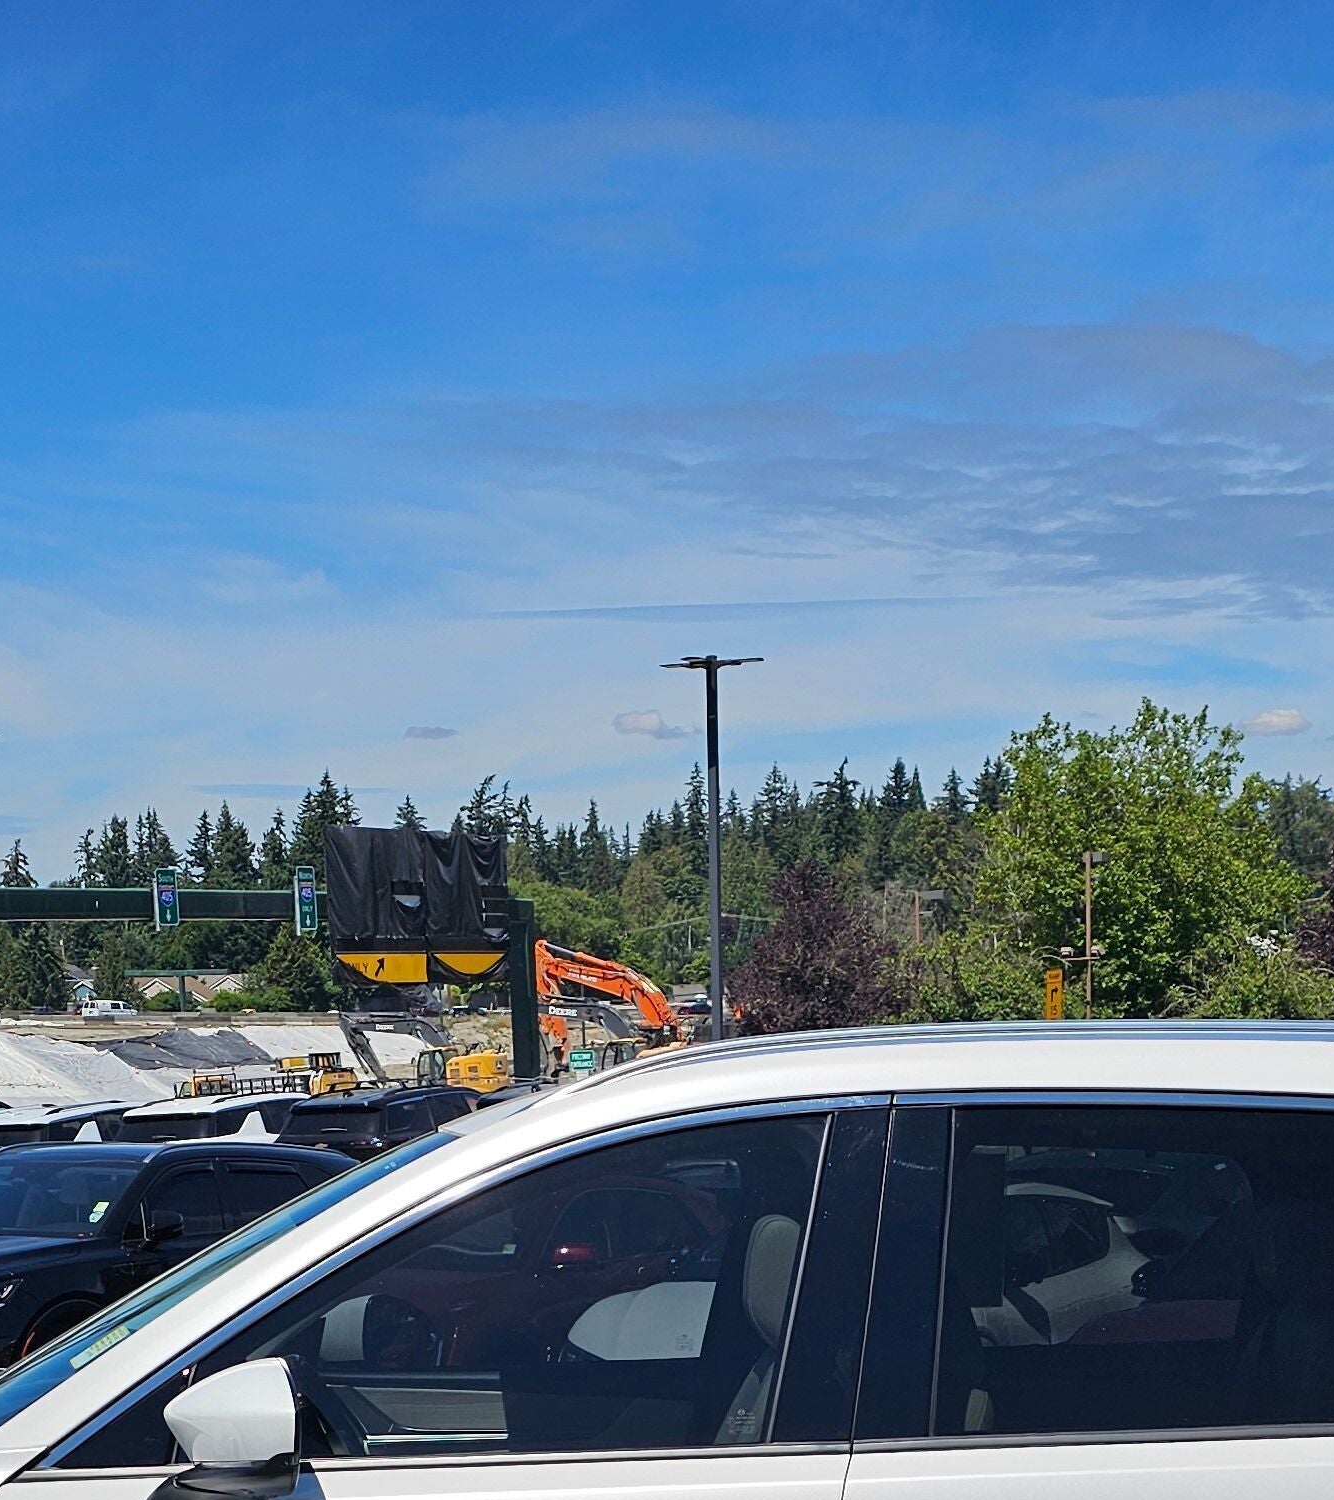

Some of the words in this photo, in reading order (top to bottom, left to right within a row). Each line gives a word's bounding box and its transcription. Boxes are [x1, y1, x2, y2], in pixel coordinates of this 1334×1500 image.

[161, 891, 174, 902] 405
[302, 887, 313, 898] 405
[348, 962, 369, 974] NLY
